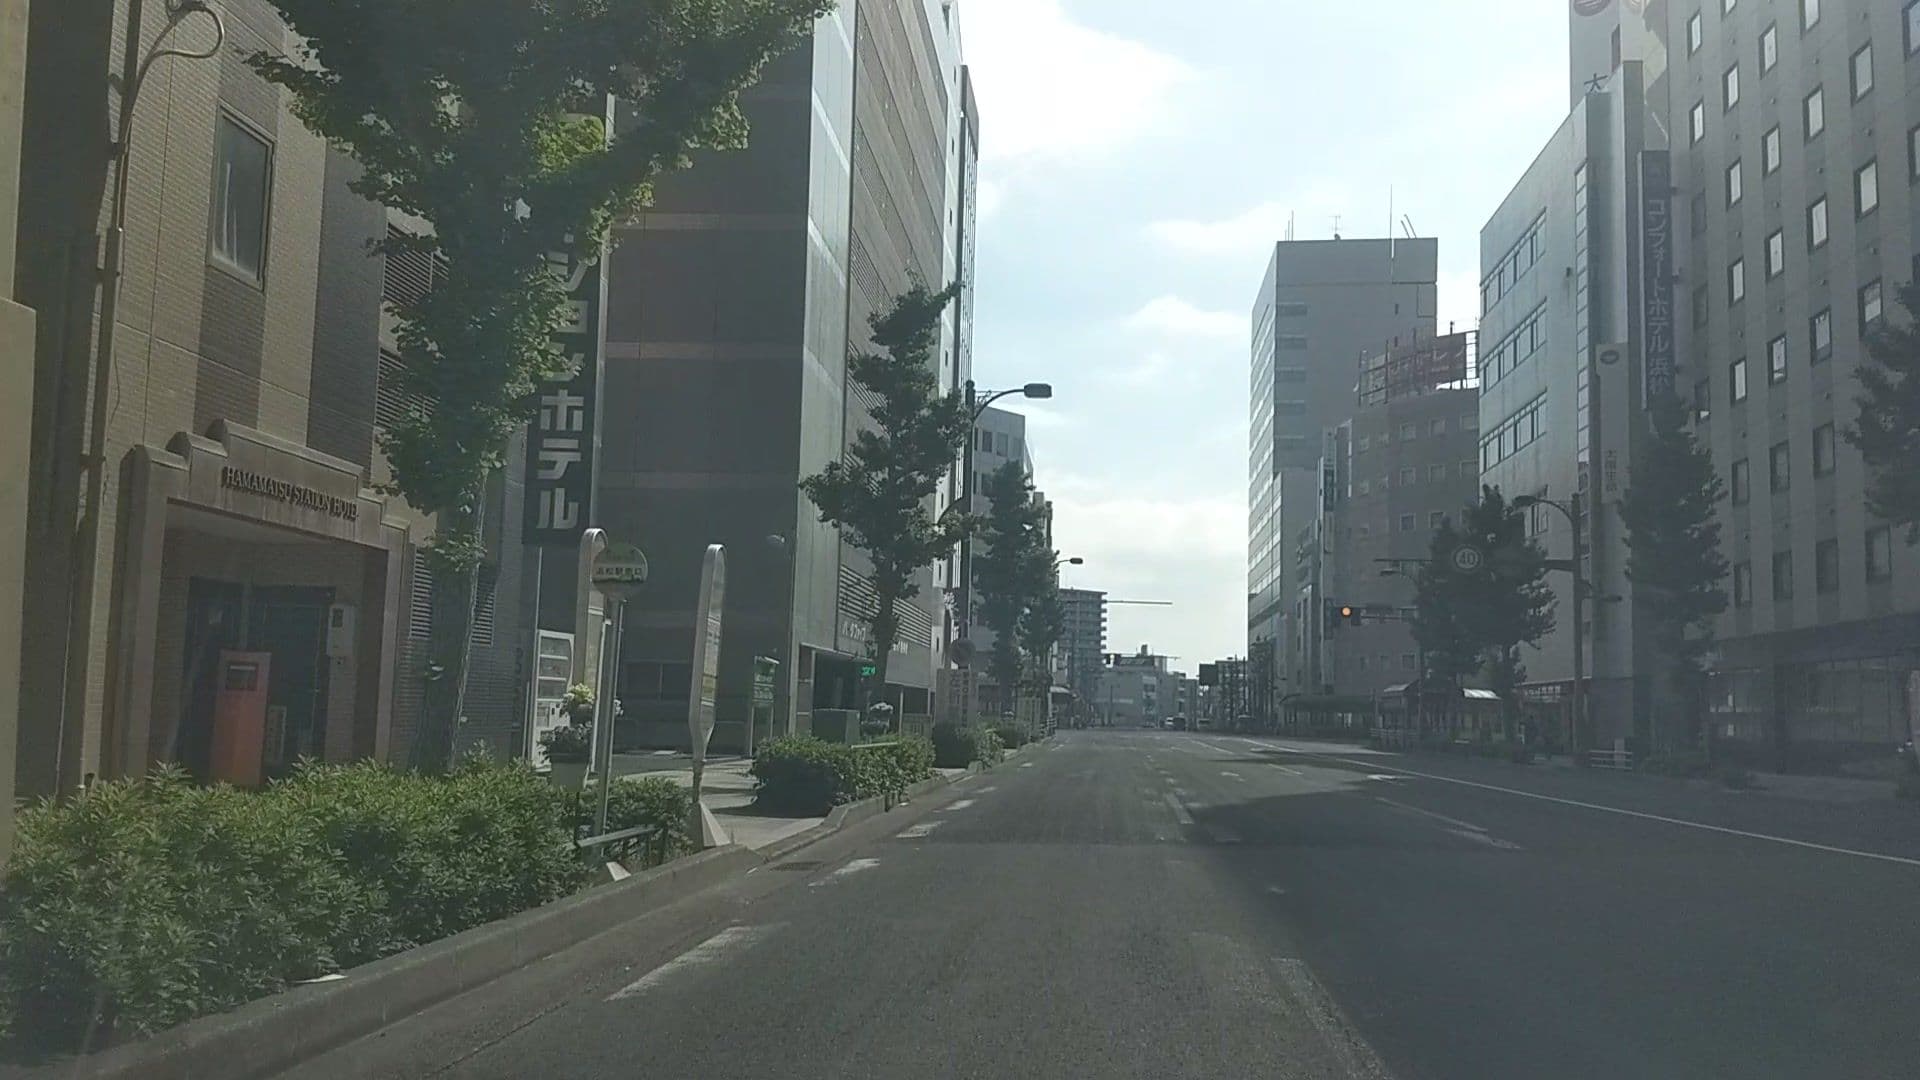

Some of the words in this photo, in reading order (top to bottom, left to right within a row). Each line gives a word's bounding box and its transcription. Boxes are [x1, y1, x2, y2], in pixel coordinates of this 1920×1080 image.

[221, 466, 291, 502] HAMAMATSU
[291, 486, 329, 511] STATION
[329, 497, 359, 521] HOTEL
[1458, 551, 1476, 565] 40
